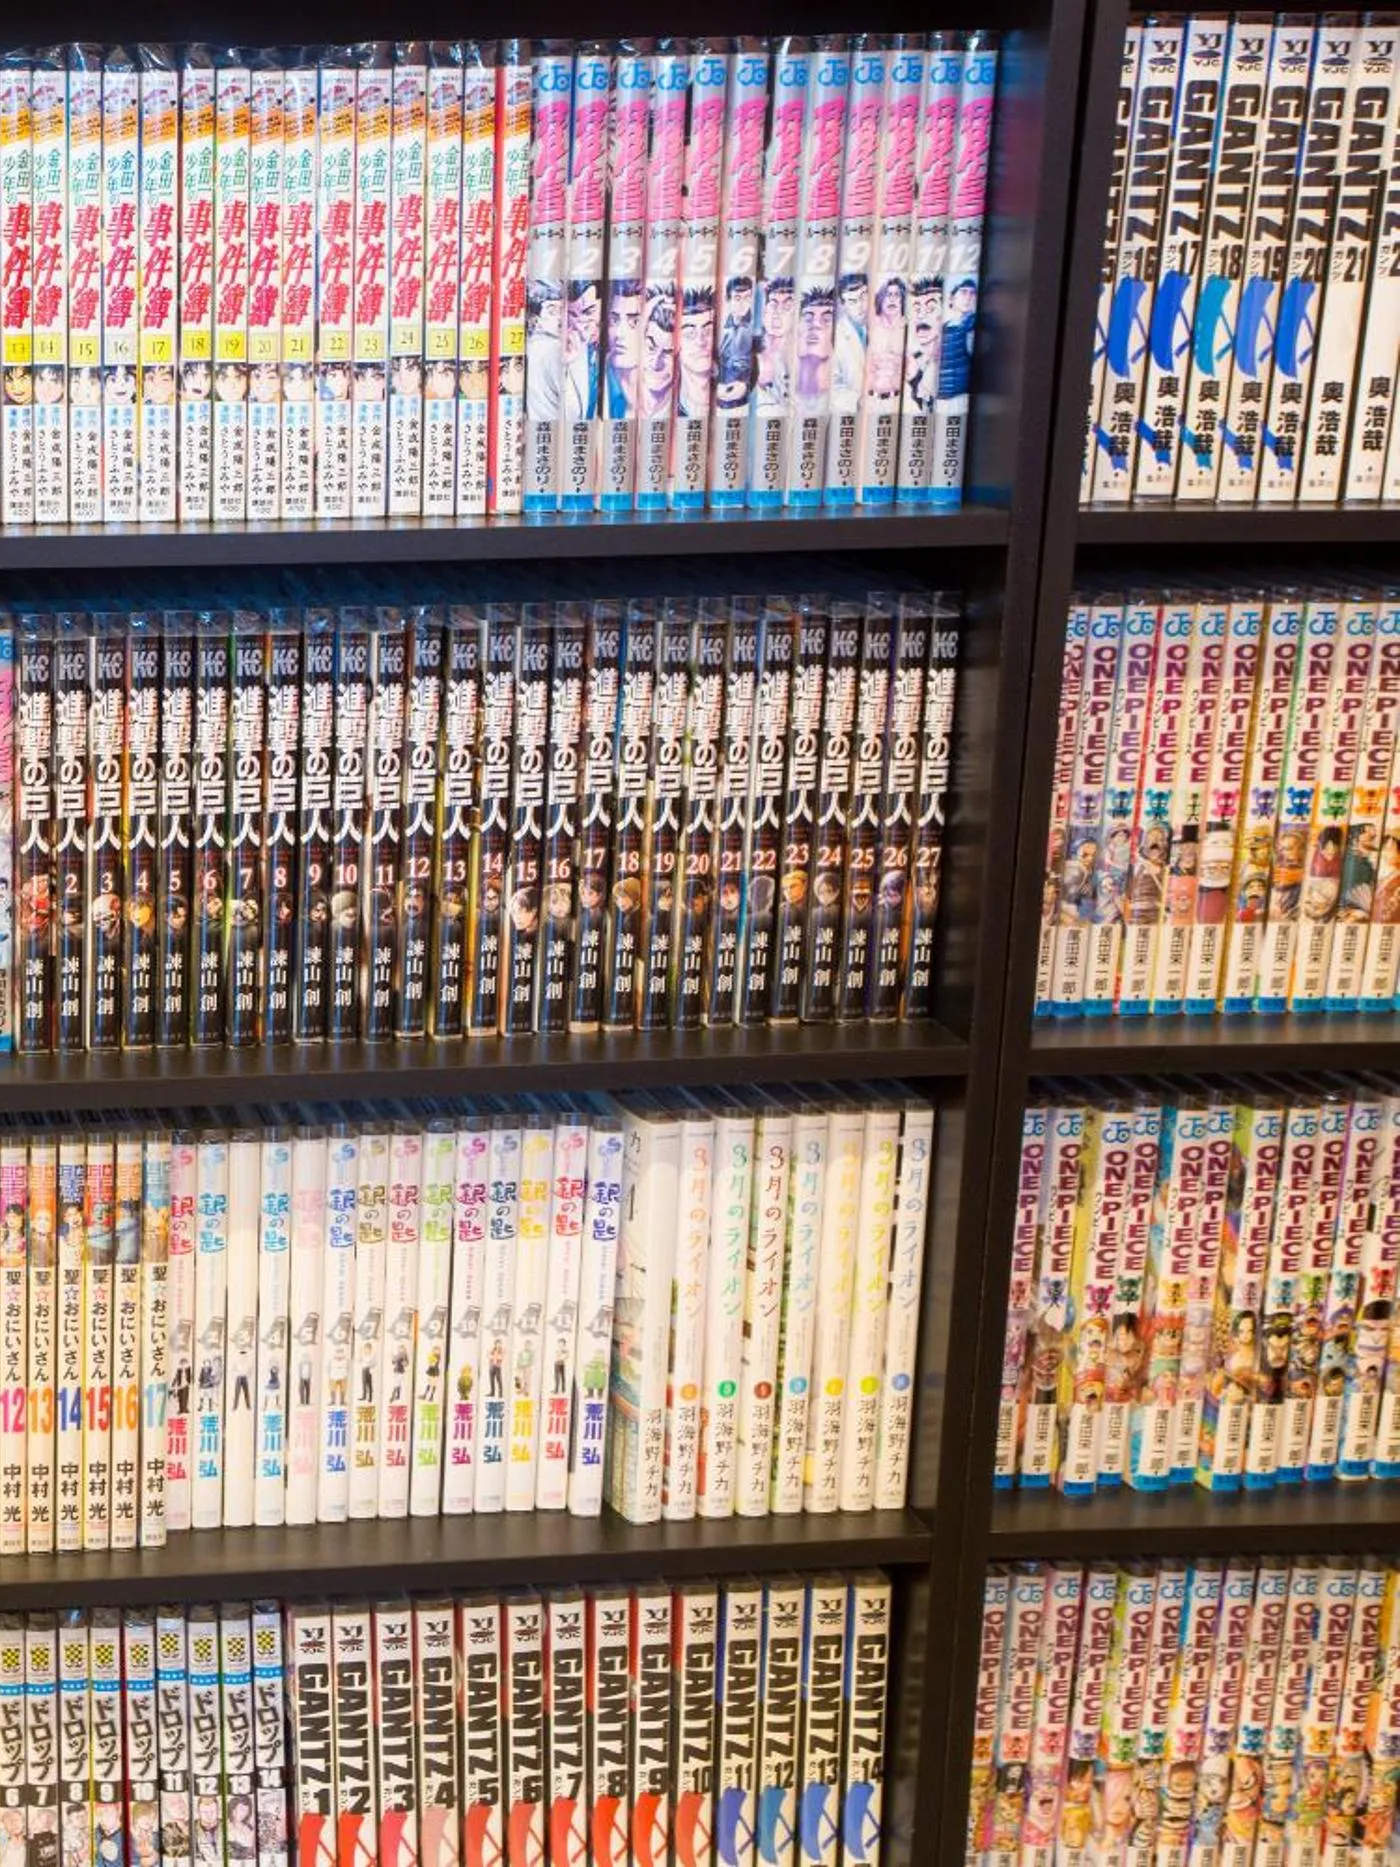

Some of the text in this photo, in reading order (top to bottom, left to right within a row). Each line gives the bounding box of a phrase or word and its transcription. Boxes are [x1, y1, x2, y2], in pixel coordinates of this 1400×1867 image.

[1195, 33, 1222, 51] YJ
[1326, 41, 1351, 59] YJ
[1126, 86, 1175, 240] GANTZ
[1211, 84, 1261, 239] GANTZ
[1339, 87, 1389, 240] GANTZ
[144, 203, 174, 331] 事件簿
[283, 201, 312, 325] 事件簿
[428, 200, 457, 325] 事件簿
[805, 244, 834, 269] 8
[880, 244, 909, 270] 10
[949, 243, 980, 271] 12
[1134, 247, 1155, 281] 16
[1220, 245, 1241, 279] 18
[1304, 249, 1326, 280] 20
[1345, 248, 1366, 280] 21
[78, 342, 93, 357] 15
[151, 341, 165, 356] 17
[291, 338, 305, 352] 21
[400, 333, 414, 346] 24
[1316, 382, 1344, 455] 奥浩哉
[1363, 377, 1390, 451] 奥浩哉
[572, 424, 588, 484] 森田まさのり
[726, 418, 741, 479] 森田まさのり
[942, 416, 957, 479] 森田まさのり
[1118, 643, 1152, 781] ONE PIECE
[1299, 643, 1334, 781] ONE PIECE
[19, 691, 51, 854] 進撃の巨人
[93, 688, 124, 851] 進撃の巨人
[160, 687, 191, 849] 進撃の巨人
[301, 682, 333, 844] 進撃の巨人
[617, 673, 652, 832] 進撃の巨人
[787, 666, 824, 826] 進撃の巨人
[64, 874, 77, 893] 2
[169, 871, 181, 889] 5
[337, 864, 356, 884] 10
[443, 861, 466, 881] 13
[518, 861, 537, 881] 15
[582, 849, 605, 869] 17
[785, 845, 809, 863] 23
[917, 846, 940, 867] 27
[263, 1194, 289, 1252] 銀の匙
[457, 1183, 485, 1242] 銀の匙
[592, 1183, 620, 1241] 銀の匙
[723, 1144, 748, 1316] 3月のライオン
[759, 1145, 784, 1317] 3月のライオン
[899, 1138, 927, 1308] 3月のライオン
[1052, 1144, 1081, 1272] ONE PIECE
[1282, 1144, 1315, 1272] ONE PIECE
[0, 1388, 26, 1432] 12
[146, 1383, 167, 1427] 17
[452, 1403, 472, 1464] 荒川弘
[583, 1403, 602, 1464] 荒川弘
[200, 1416, 219, 1478] 荒川弘
[716, 1404, 735, 1491] 羽海野チカ
[888, 1397, 908, 1486] 羽海野チカ
[852, 1634, 885, 1756] GANTZ
[1048, 1606, 1077, 1724] ONE PIECE
[1219, 1606, 1249, 1724] ONE PIECE
[162, 1687, 185, 1766] ドロップ
[300, 1662, 331, 1785] GANTZ
[468, 1654, 498, 1772] GANTZ
[100, 1782, 113, 1800] 9
[314, 1788, 329, 1814] 1
[350, 1788, 370, 1814] 2
[692, 1765, 714, 1791] 10
